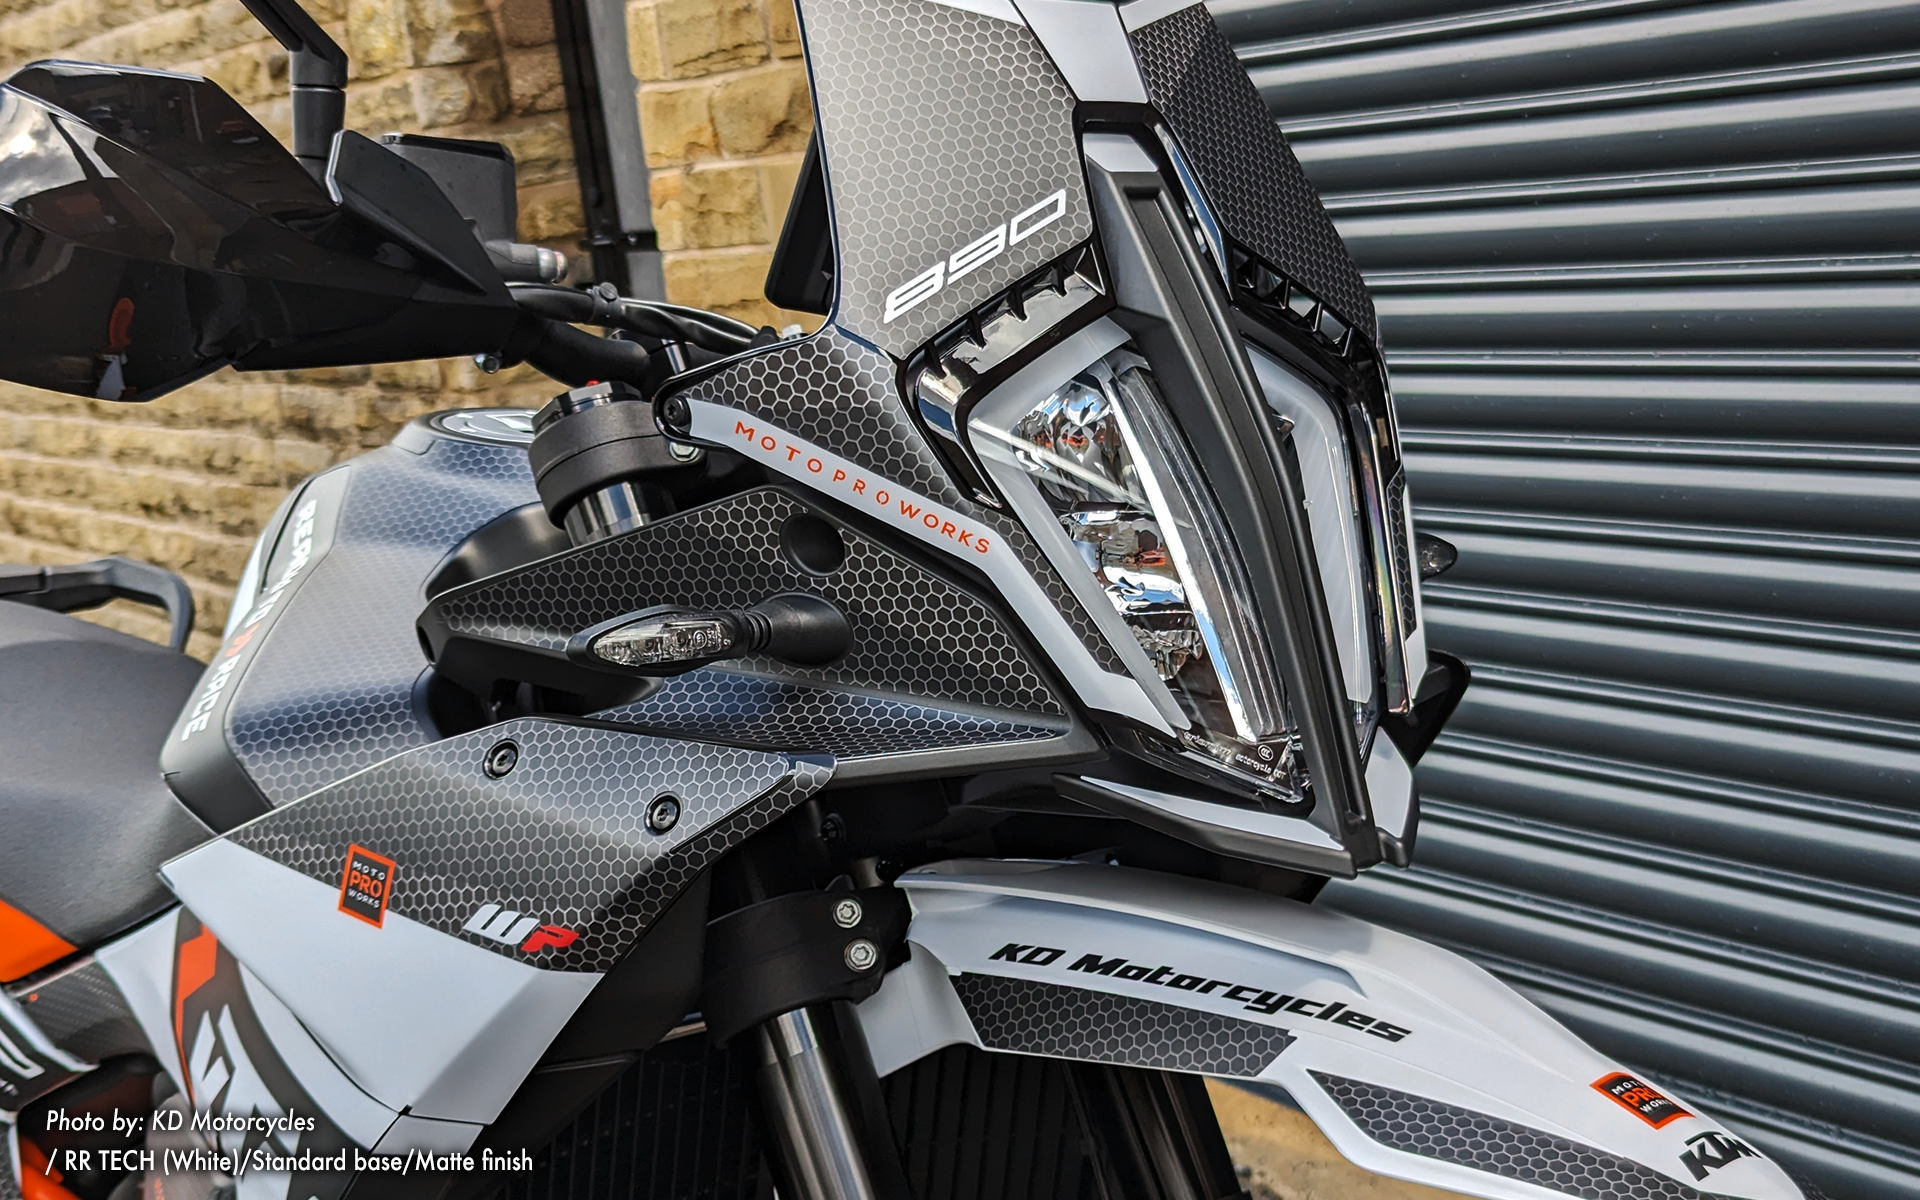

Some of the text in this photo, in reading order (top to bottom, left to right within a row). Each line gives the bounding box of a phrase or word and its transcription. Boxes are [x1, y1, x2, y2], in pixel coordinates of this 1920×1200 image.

[882, 188, 1067, 325] 890
[181, 654, 241, 741] RACE
[349, 869, 383, 898] PRO
[352, 861, 386, 881] MOTO
[347, 888, 381, 909] WORKS
[462, 903, 580, 953] WP
[988, 943, 1412, 1043] KD Motorcycles
[1679, 1130, 1763, 1182] KTM
